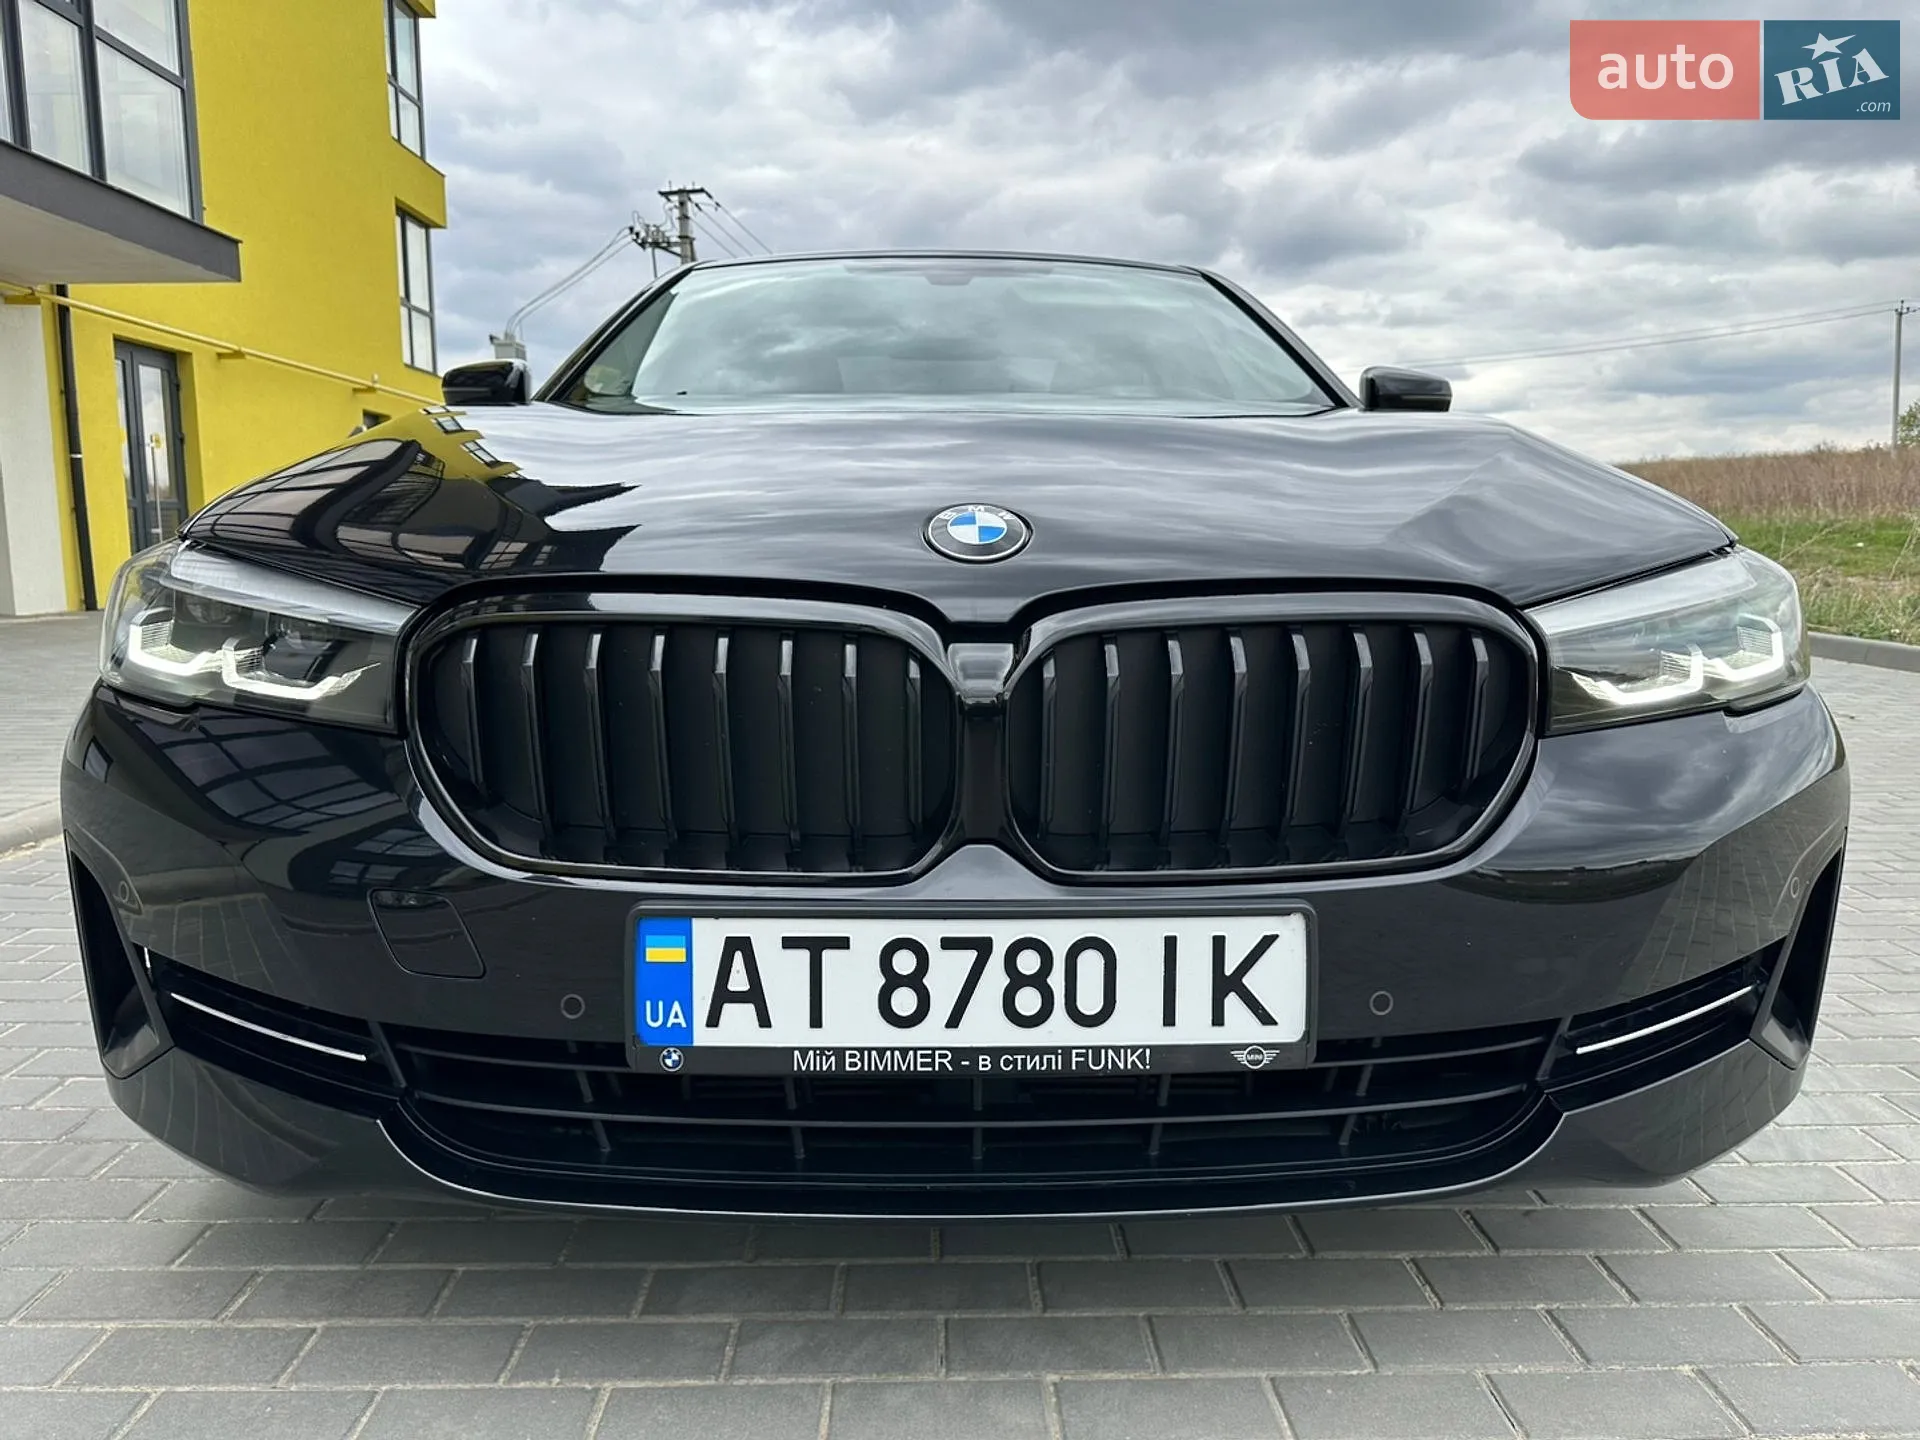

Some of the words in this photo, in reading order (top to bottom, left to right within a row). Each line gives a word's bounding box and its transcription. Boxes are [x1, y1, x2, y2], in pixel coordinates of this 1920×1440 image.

[704, 935, 851, 1030] AT
[877, 936, 1118, 1030] 8780
[1162, 933, 1280, 1028] IK
[645, 999, 687, 1028] UA
[793, 1050, 836, 1071] Мій
[845, 1050, 953, 1071] BIMMER
[978, 1055, 992, 1071] в
[1000, 1049, 1062, 1071] стилі
[1071, 1048, 1151, 1070] FUNK!
